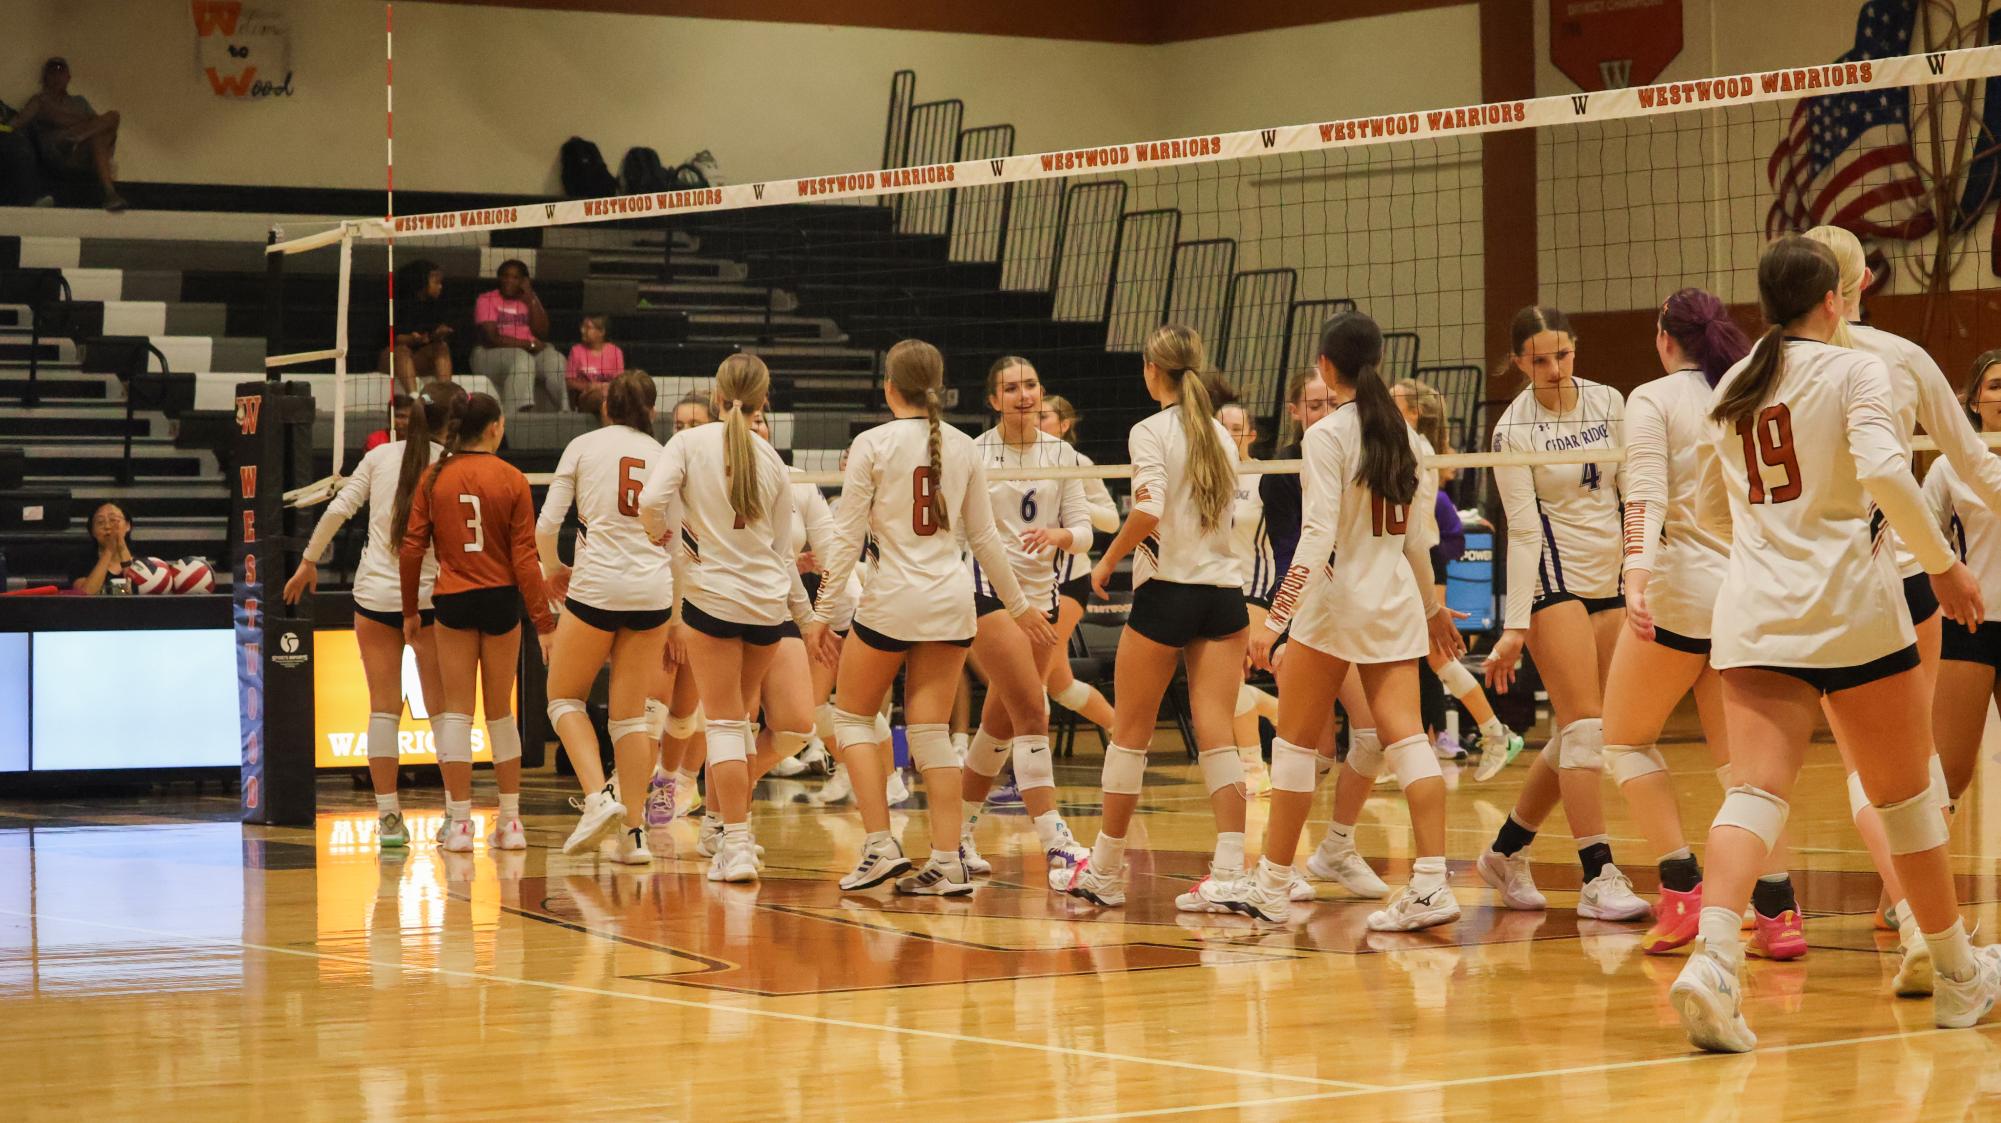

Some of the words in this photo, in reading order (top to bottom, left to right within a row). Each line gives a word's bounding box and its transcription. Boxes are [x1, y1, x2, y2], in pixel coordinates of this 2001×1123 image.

[228, 45, 249, 58] to
[205, 67, 294, 97] Wood
[395, 214, 455, 232] WESTWOOD
[460, 207, 517, 226] WARRIORS
[545, 204, 556, 219] W
[584, 198, 652, 217] WESTWOOD
[656, 188, 722, 209] WARRIORS
[753, 184, 765, 200] W
[797, 173, 875, 197] WESTWOOD
[879, 164, 955, 188] WARRIORS
[990, 160, 1004, 177] W
[1040, 147, 1129, 172] WESTWOOD
[1136, 136, 1221, 162] WARRIORS
[1261, 130, 1277, 149] W
[1319, 114, 1419, 142] WESTWOOD
[1427, 102, 1525, 131] WARRIORS
[1571, 95, 1589, 115] W
[1638, 76, 1752, 109] WESTWOOD
[1761, 62, 1873, 94] WARRIORS
[1926, 53, 1946, 76] W
[1545, 434, 1581, 451] CEDAR
[1735, 402, 1802, 505] 19
[618, 456, 646, 517] 6
[912, 465, 940, 536] 8
[1580, 463, 1601, 492] 4
[459, 494, 484, 553] 3
[1021, 488, 1037, 523] 6
